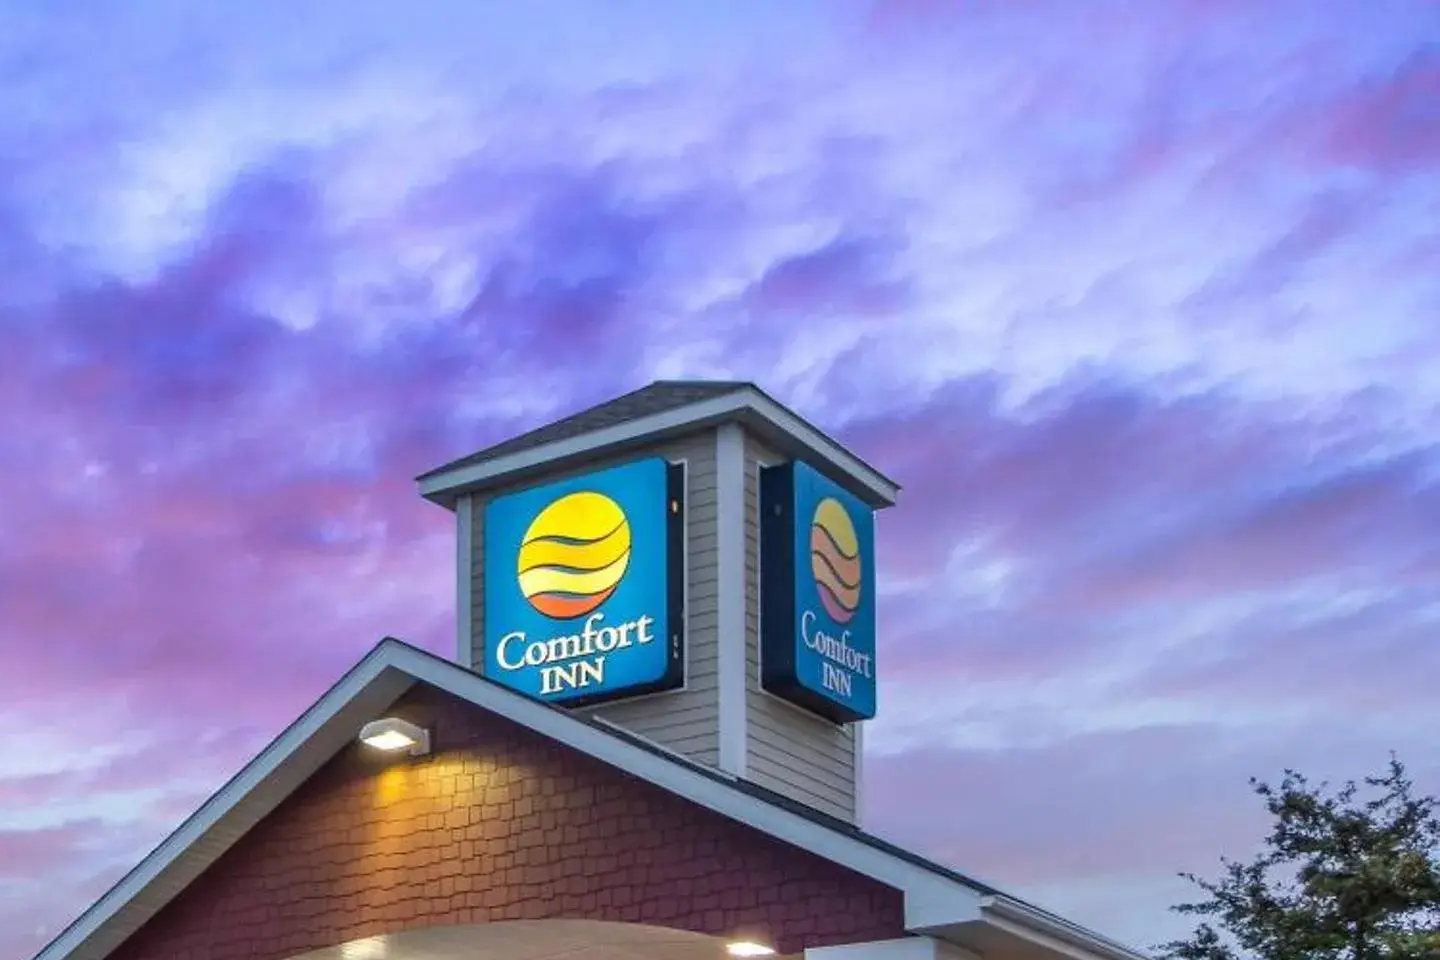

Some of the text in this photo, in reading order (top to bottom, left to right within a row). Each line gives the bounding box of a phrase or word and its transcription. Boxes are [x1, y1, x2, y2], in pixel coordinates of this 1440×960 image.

[496, 612, 655, 670] Comfort
[802, 610, 872, 679] Comfort
[540, 656, 605, 695] INN
[823, 661, 852, 697] INN
